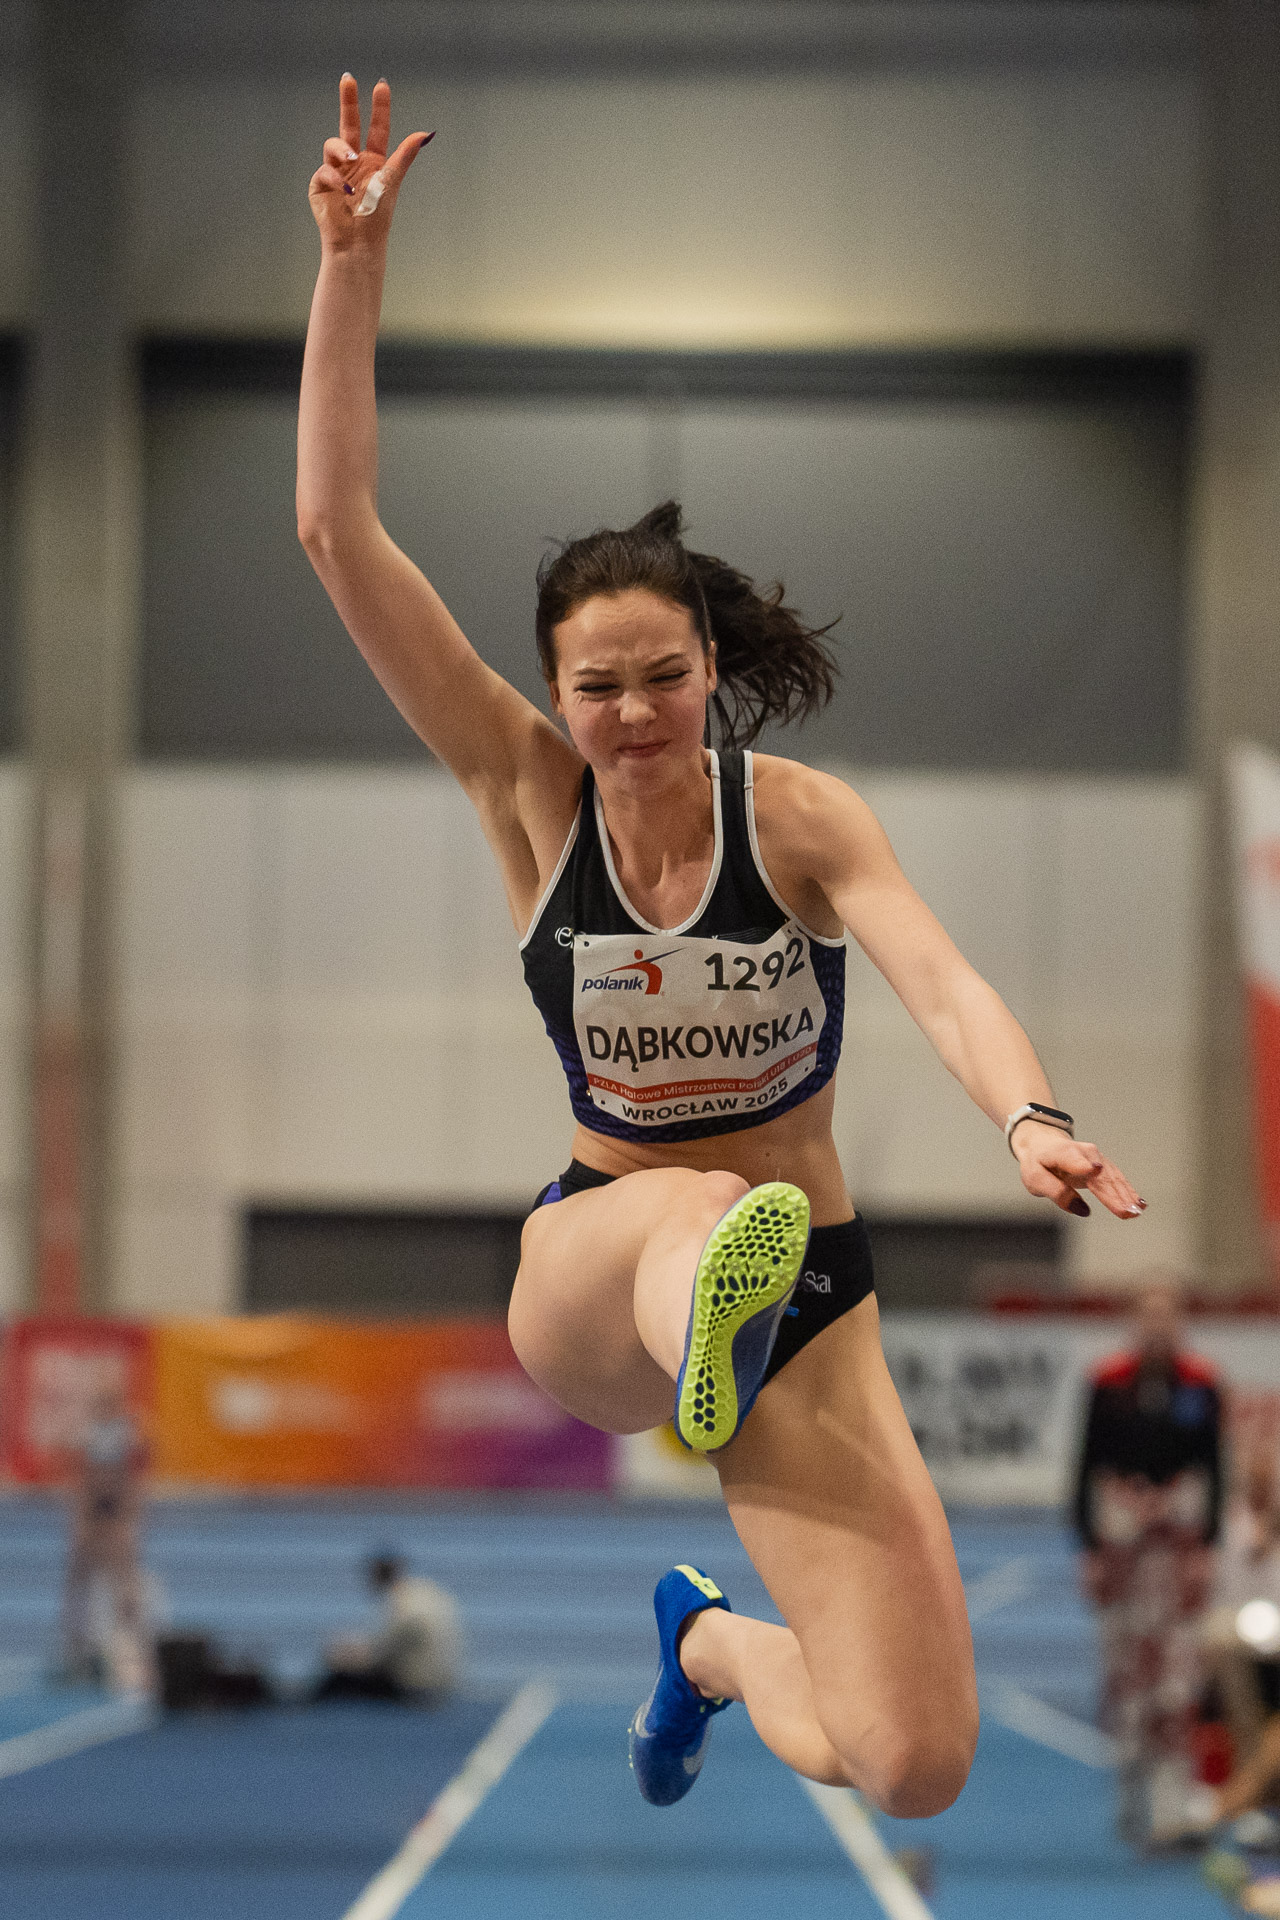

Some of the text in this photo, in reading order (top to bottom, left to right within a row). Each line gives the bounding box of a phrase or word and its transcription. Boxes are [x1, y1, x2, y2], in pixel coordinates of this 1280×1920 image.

[581, 975, 645, 993] polanik
[704, 937, 805, 992] 1292
[586, 1006, 814, 1073] DĄBKOWSKA
[620, 1086, 662, 1101] Halowe
[664, 1081, 736, 1097] Mistrzostwa
[738, 1073, 769, 1090] Polski
[622, 1077, 788, 1122] WROCŁAW 2025
